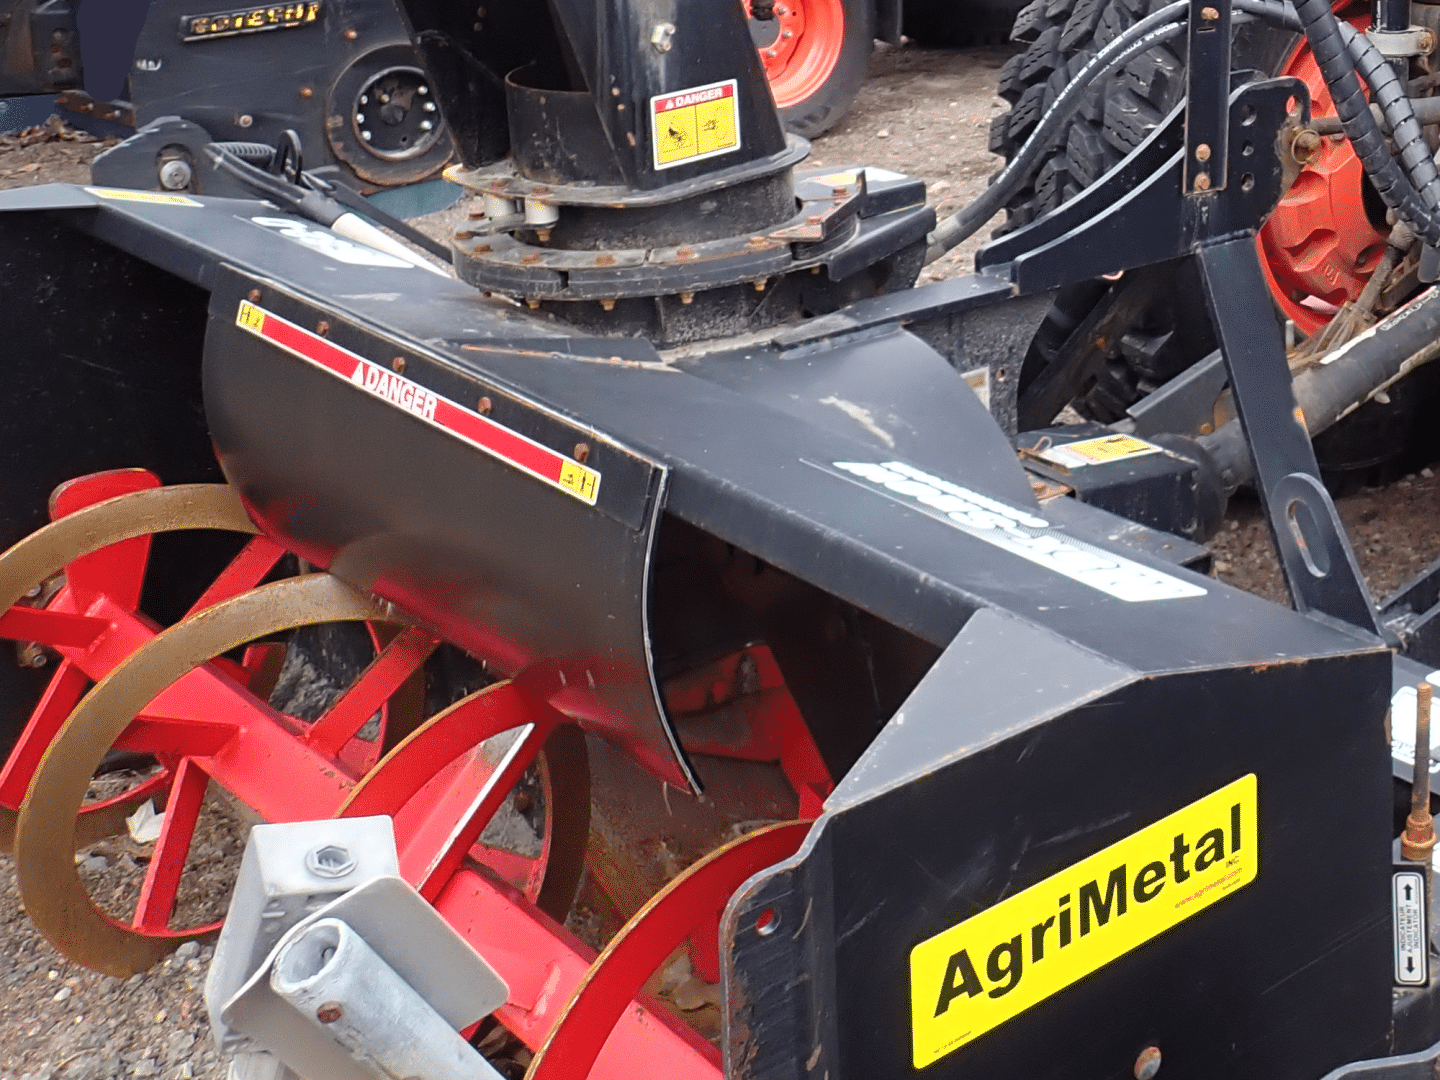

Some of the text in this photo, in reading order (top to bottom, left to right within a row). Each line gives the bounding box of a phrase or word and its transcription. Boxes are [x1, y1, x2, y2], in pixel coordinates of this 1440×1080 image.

[675, 87, 724, 108] DANGER
[365, 365, 438, 421] DANGER
[933, 802, 1242, 1018] AgriMetal
